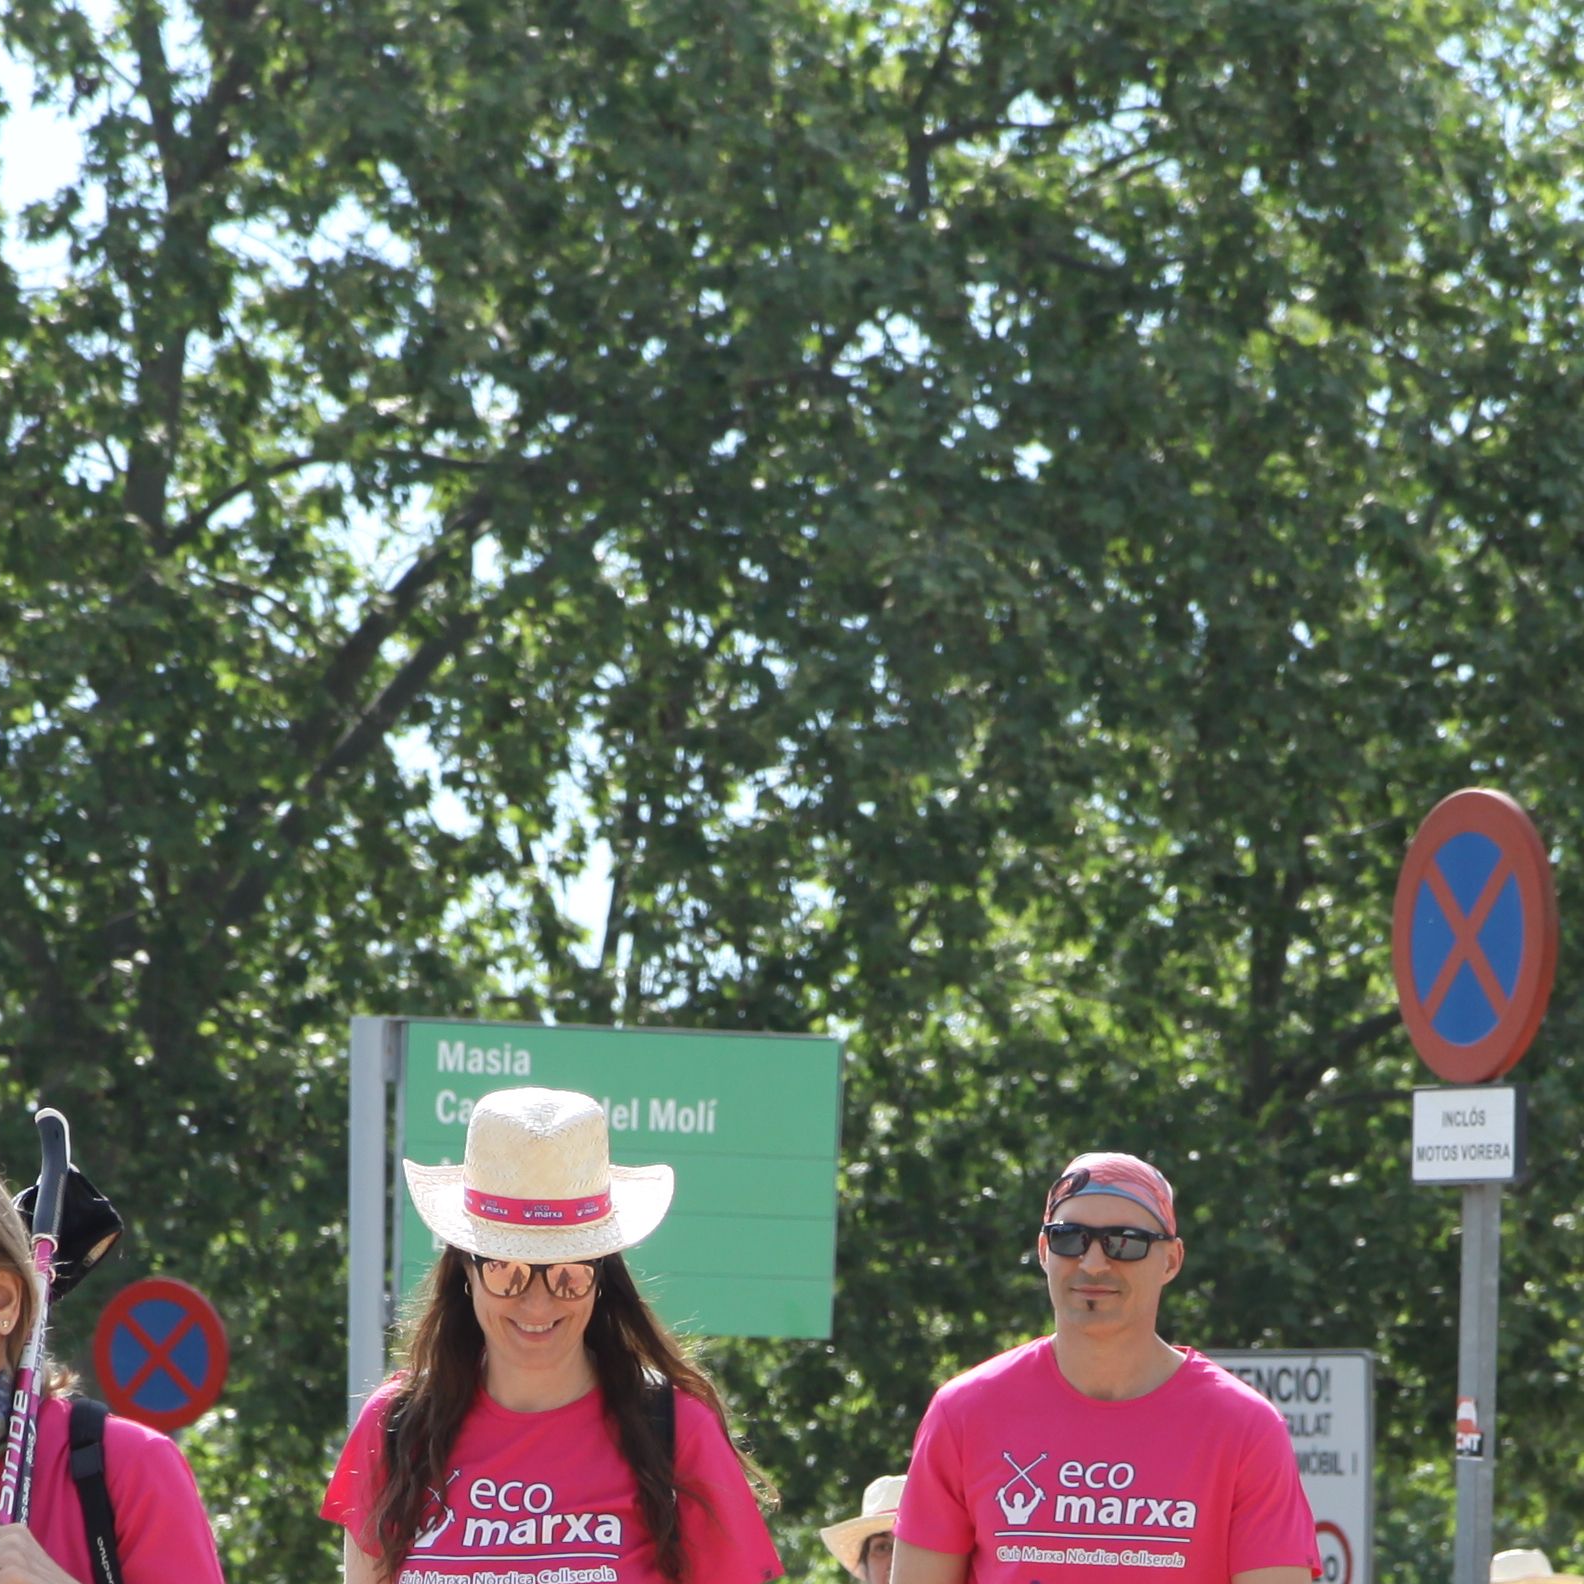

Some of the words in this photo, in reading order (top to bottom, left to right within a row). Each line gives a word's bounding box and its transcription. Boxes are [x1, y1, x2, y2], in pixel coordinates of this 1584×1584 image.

[437, 1041, 531, 1076] Masia
[648, 1098, 718, 1134] Molí
[1441, 1107, 1486, 1127] INCLÓS
[1416, 1145, 1458, 1161] MOTOS
[1461, 1143, 1511, 1160] VORERA
[1059, 1460, 1135, 1490] eco
[470, 1478, 554, 1514] eco
[1054, 1494, 1197, 1529] marxa
[462, 1513, 623, 1547] marxa
[1022, 1546, 1064, 1562] Marxa
[1066, 1548, 1118, 1565] Nòrdica
[1120, 1549, 1185, 1568] Collserola
